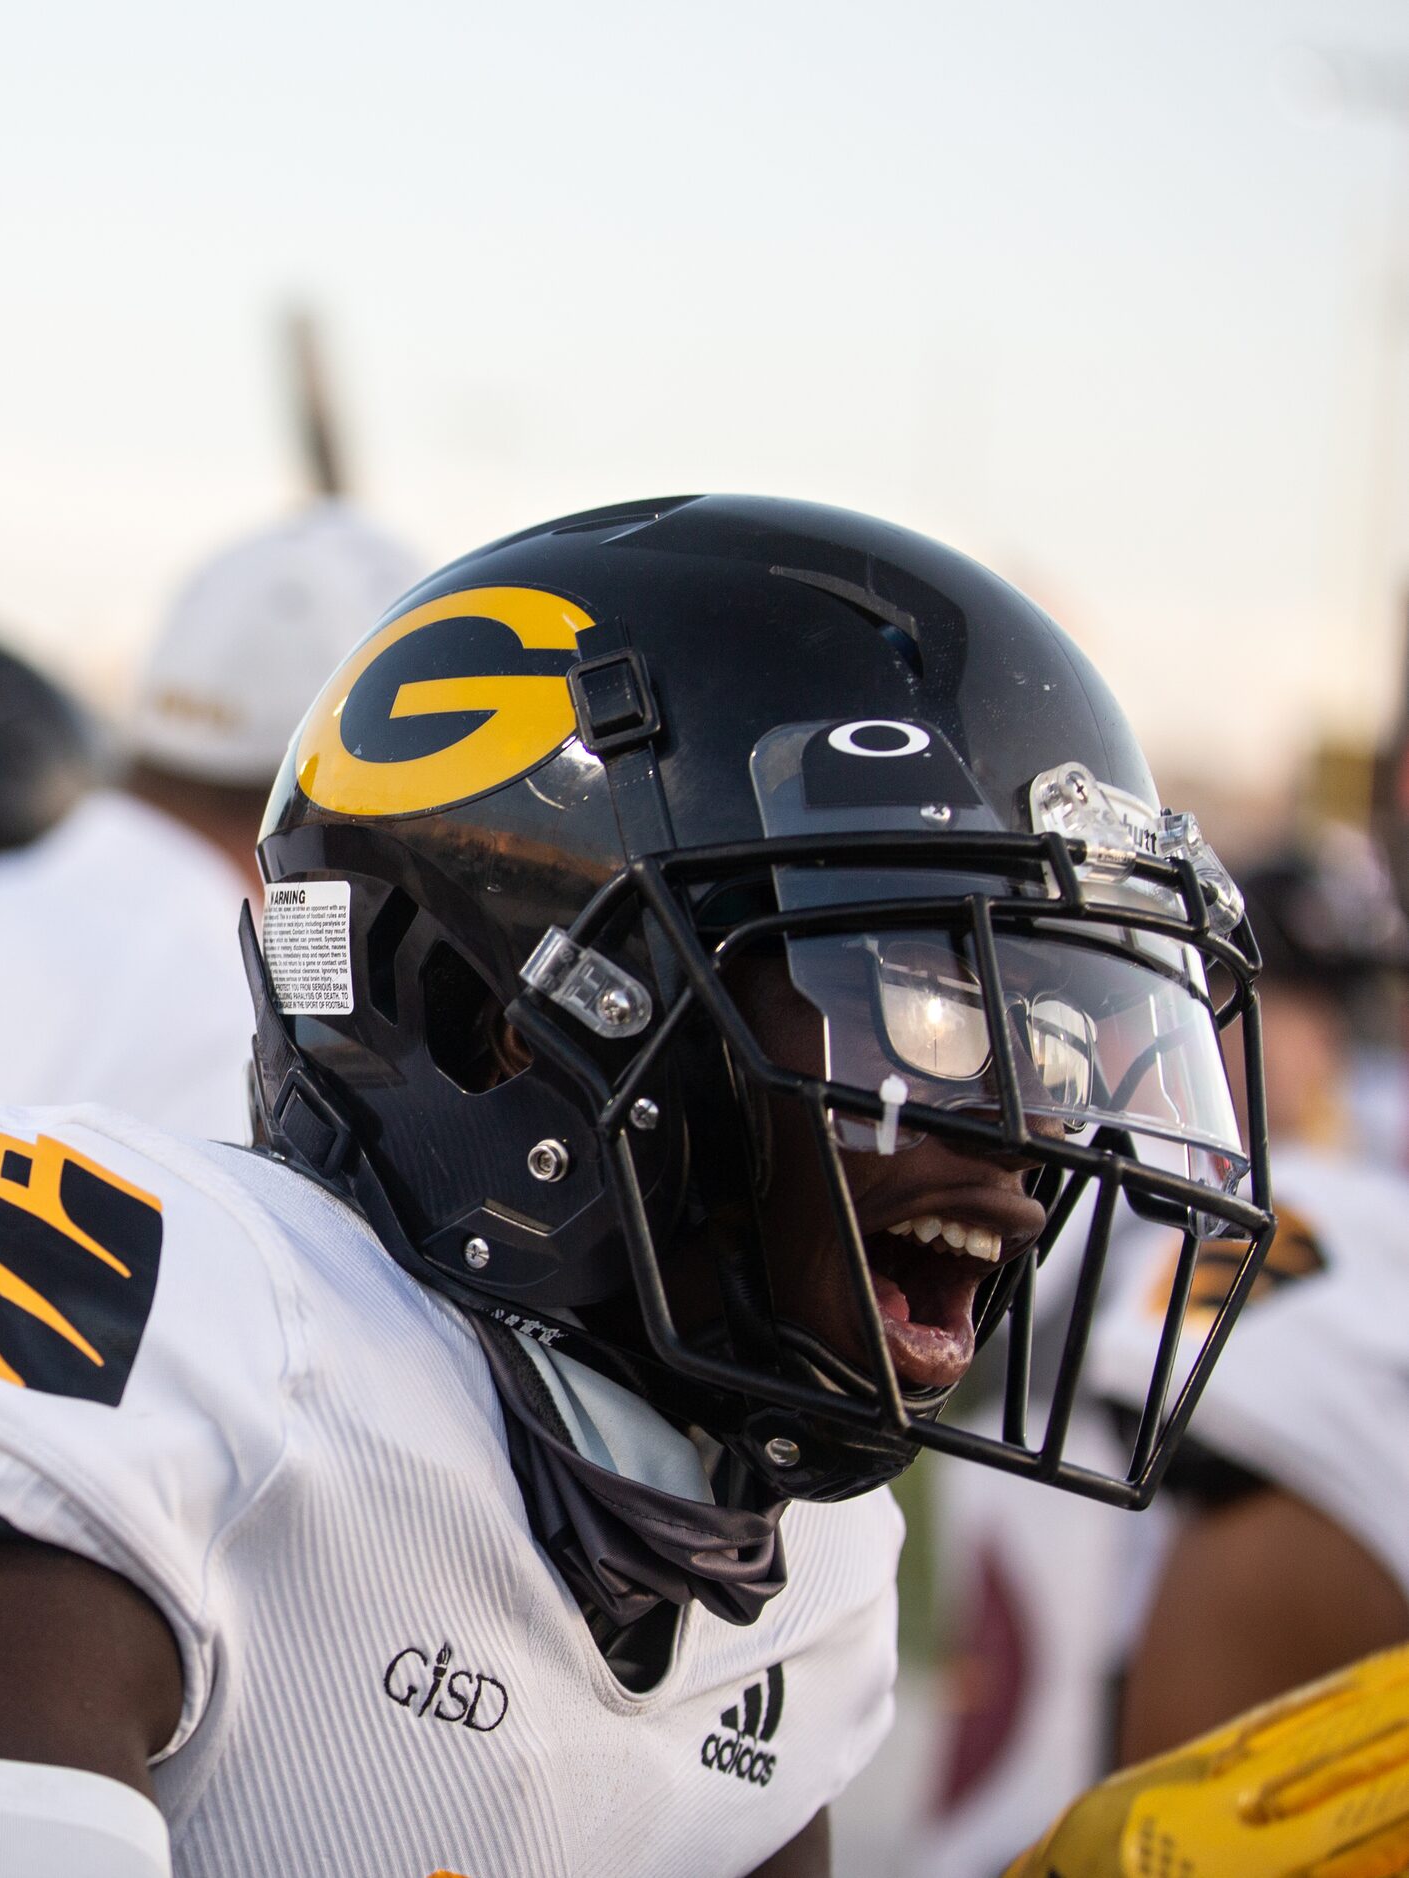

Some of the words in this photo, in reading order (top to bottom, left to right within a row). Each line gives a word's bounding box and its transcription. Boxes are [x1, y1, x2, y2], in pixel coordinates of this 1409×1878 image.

[295, 586, 596, 815] G
[312, 983, 332, 991] SERIOUS
[333, 983, 348, 991] BRAIN
[325, 1001, 350, 1009] FOOTBALL
[701, 1729, 777, 1787] adidas
